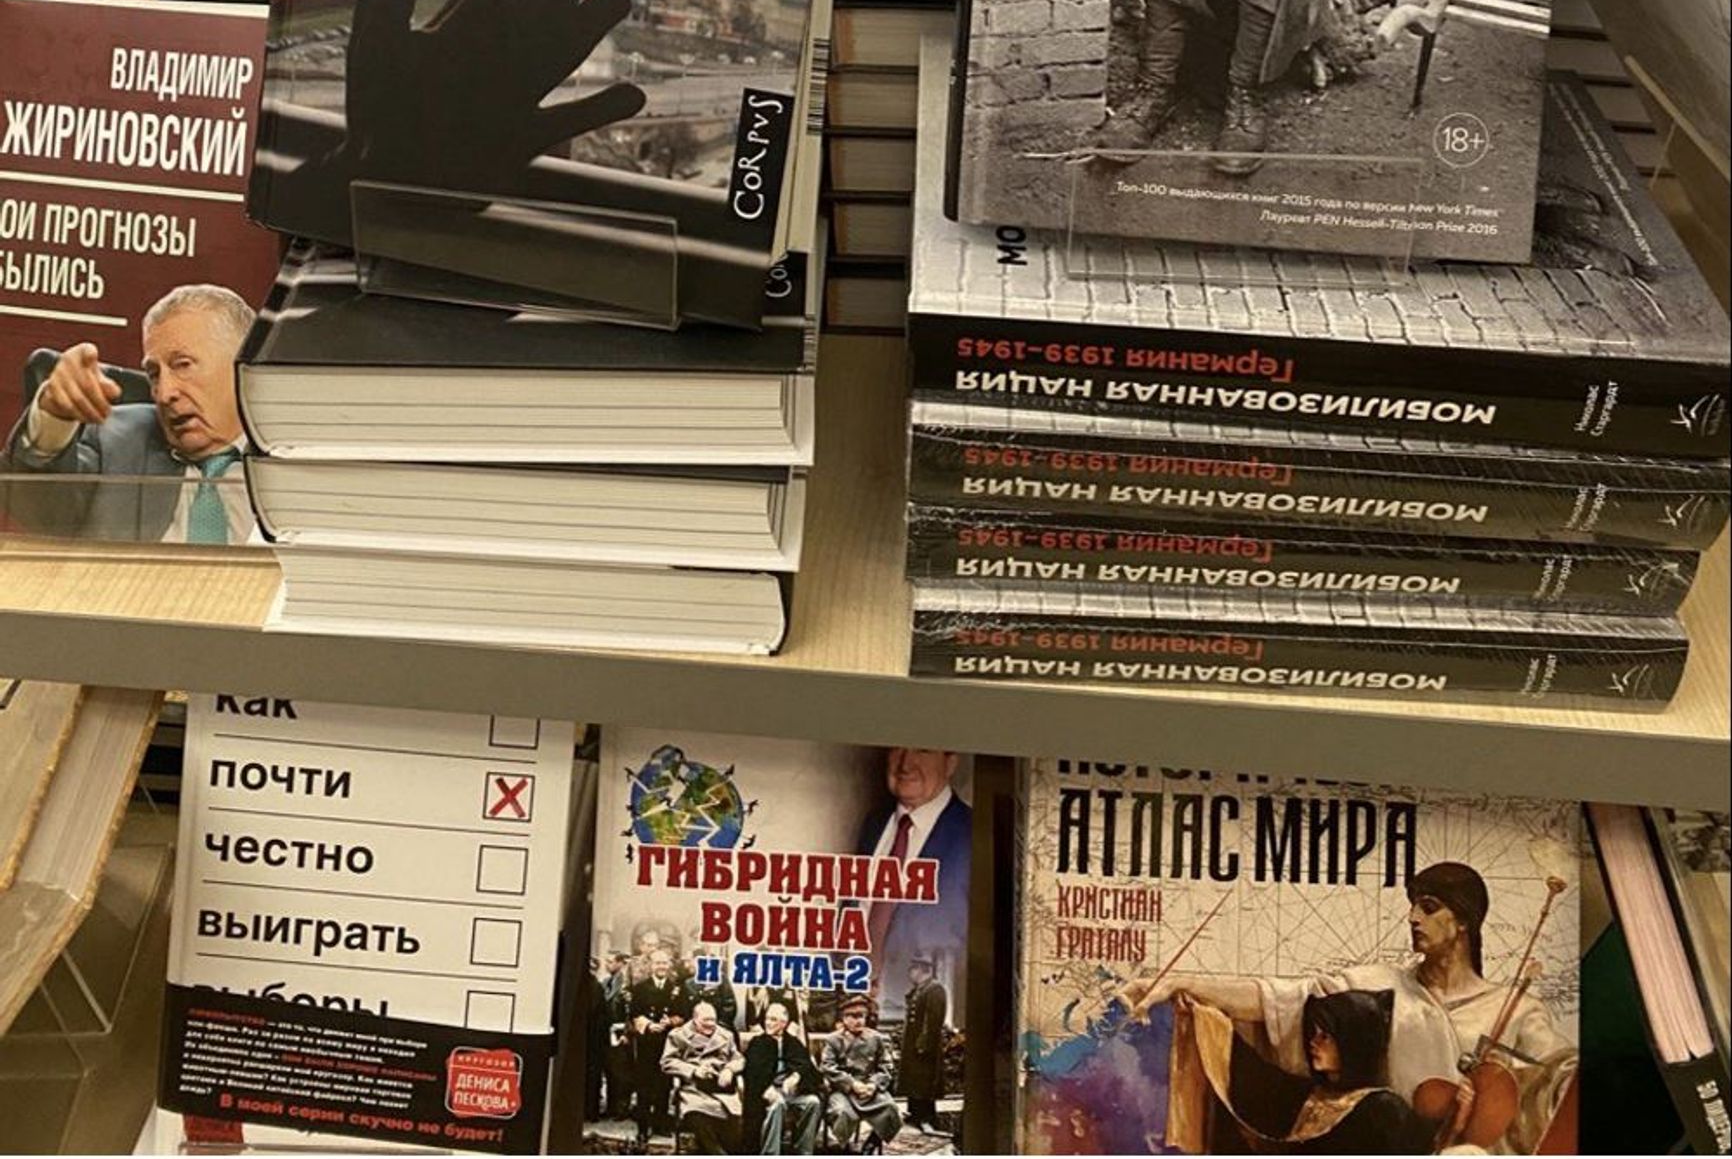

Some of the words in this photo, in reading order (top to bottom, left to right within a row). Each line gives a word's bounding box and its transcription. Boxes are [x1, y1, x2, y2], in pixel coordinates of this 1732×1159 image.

[110, 46, 255, 103] ВЛАДИМИР
[0, 98, 248, 178] ЖИРИНОВСКИЙ
[1442, 126, 1486, 155] 18+
[1117, 180, 1168, 196] Топ-100
[1170, 187, 1250, 203] выдающихся
[1252, 194, 1279, 205] книг
[1281, 193, 1312, 207] 2015
[1313, 197, 1343, 211] года
[1345, 200, 1362, 211] по
[1363, 201, 1406, 214] версии
[1436, 203, 1461, 215] York
[1464, 204, 1500, 218] Times
[42, 202, 196, 258] ПРОГНОЗЫ
[1259, 208, 1312, 225] Лауреат
[1313, 213, 1343, 226] PEN
[1435, 220, 1466, 234] Prize
[1466, 222, 1499, 236] 2016
[1124, 345, 1296, 382] Германия
[954, 368, 1094, 400] НАЦИЯ
[1106, 379, 1497, 426] МОБИЛИЗОВАННАЯ
[1574, 384, 1600, 433] Николас
[1590, 380, 1619, 437] Старгардт
[961, 474, 1098, 503] НАЦИЯ
[1130, 454, 1294, 485] Германия
[1110, 485, 1489, 525] МОБИЛИЗОВАННАЯ
[1116, 531, 1274, 563] Германия
[954, 555, 1089, 582] НАЦИЯ
[1096, 561, 1461, 595] МОБИЛИЗОВАННАЯ
[953, 652, 1085, 678] НАЦИЯ
[1110, 632, 1264, 662] Германия
[1093, 660, 1448, 693] МОБИЛИЗОВАННАЯ
[208, 758, 353, 799] почти
[204, 832, 375, 875] честно
[1056, 787, 1241, 883] АТЛАС
[1254, 794, 1418, 889] МИРА
[637, 844, 939, 904] ГИБРИДНАЯ
[1055, 885, 1163, 924] КРИСТИАН
[197, 908, 422, 958] выиграть
[700, 896, 871, 953] ВОЙНА
[1055, 925, 1147, 962] ГРАТАЛУ
[696, 957, 722, 984] и
[732, 951, 871, 993] ЯЛТА-2
[453, 1091, 510, 1112] ПЕСКОВА
[455, 1072, 511, 1094] ДЕНИСА
[219, 1093, 233, 1108] В
[237, 1098, 284, 1116] моей
[288, 1105, 346, 1124] серии
[350, 1113, 414, 1133] скучно
[417, 1119, 441, 1134] не
[444, 1122, 505, 1144] будет!
